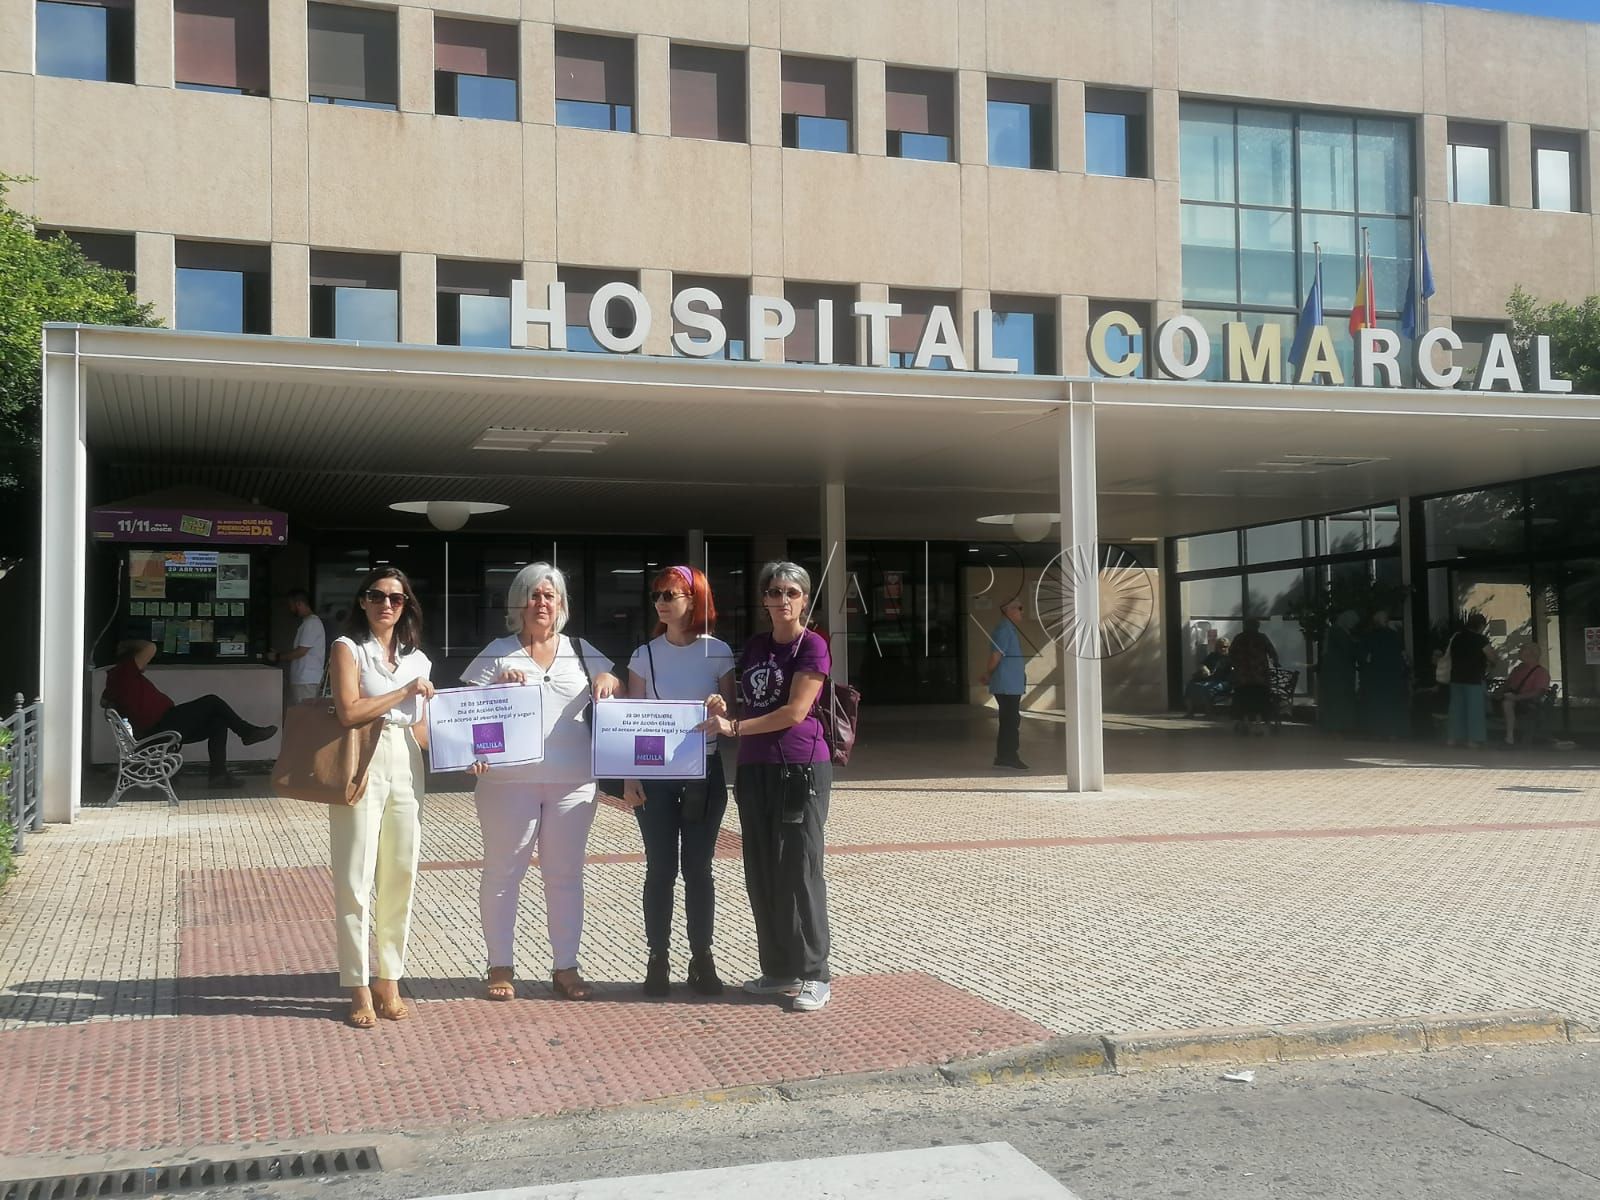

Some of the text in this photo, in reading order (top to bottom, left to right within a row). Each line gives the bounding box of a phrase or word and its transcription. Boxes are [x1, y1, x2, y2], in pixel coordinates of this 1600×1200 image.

[509, 279, 1574, 394] HOSPITAL COMARCAL
[118, 519, 150, 533] 11/11
[251, 526, 273, 536] DA
[476, 698, 509, 706] SEPTIEMBRE
[517, 711, 536, 719] seguro
[476, 741, 503, 749] MELILLA
